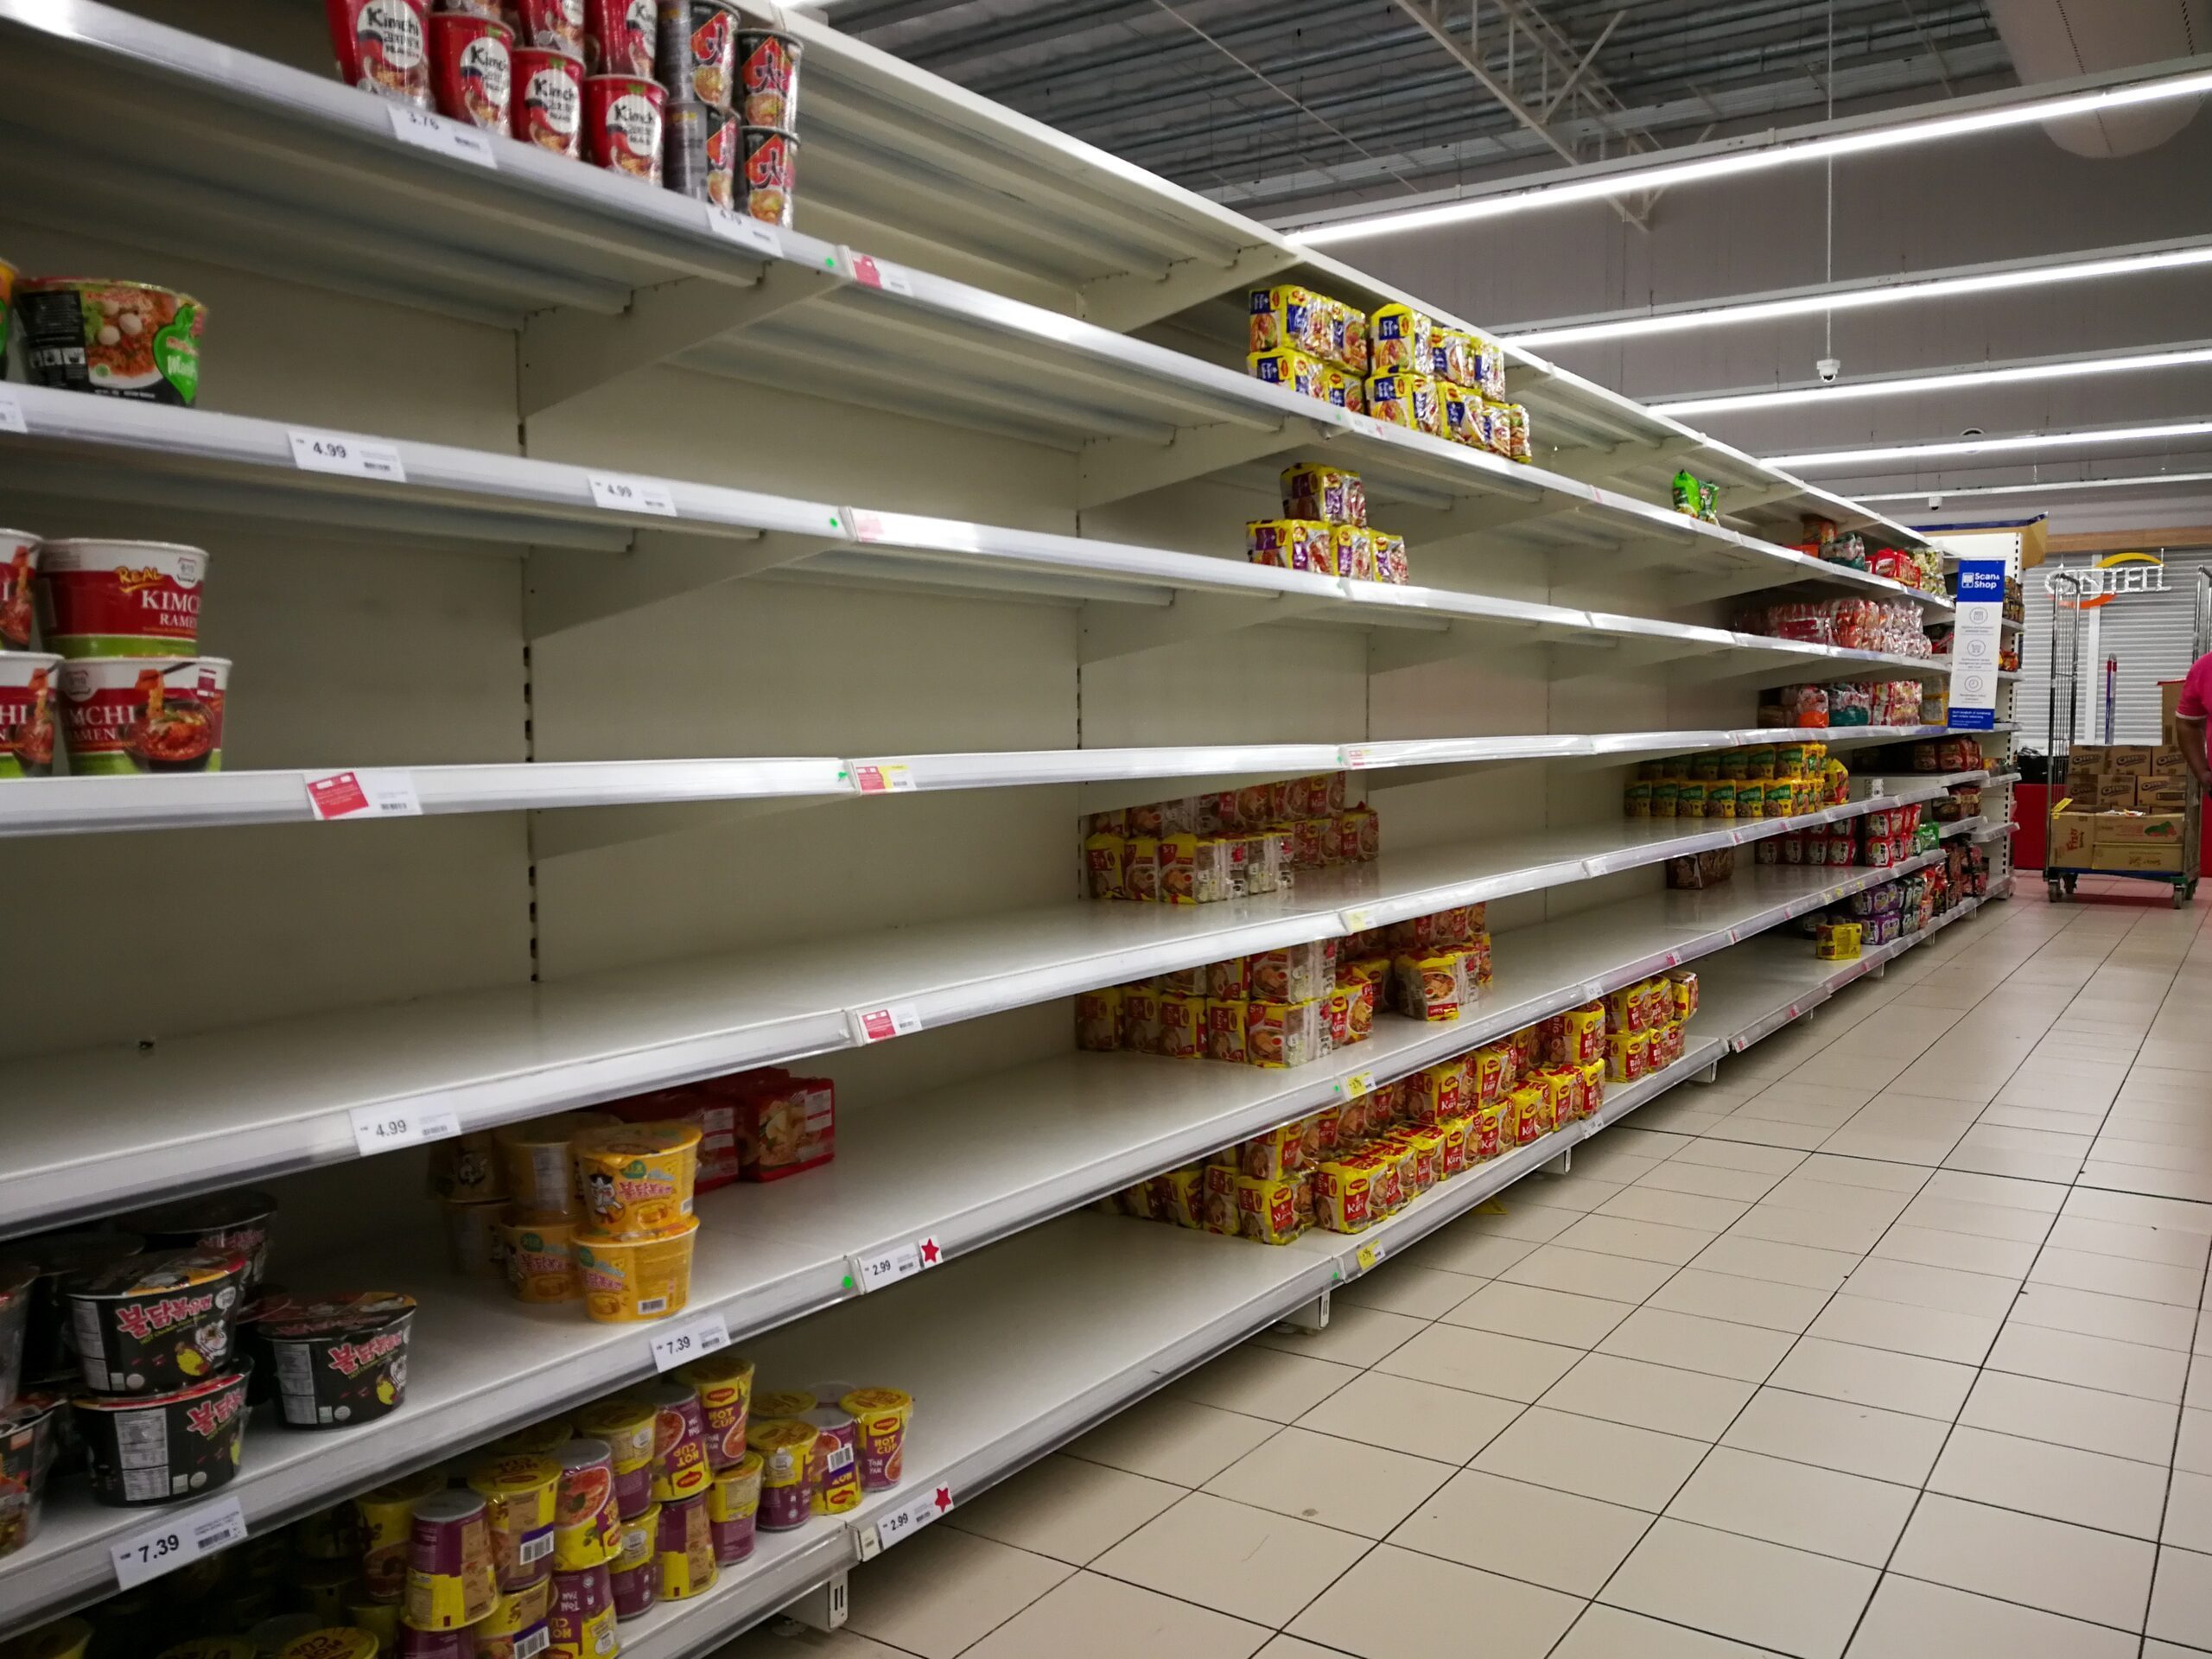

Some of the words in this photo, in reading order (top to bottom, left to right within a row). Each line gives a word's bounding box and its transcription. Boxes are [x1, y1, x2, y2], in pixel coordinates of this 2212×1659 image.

[313, 441, 347, 459] 4.99
[1974, 580, 1998, 590] Shop
[376, 1119, 407, 1138] 4.99
[872, 1260, 892, 1276] 2.99
[666, 1336, 690, 1355] 7.39
[709, 1407, 734, 1421] HOT
[712, 1416, 737, 1429] CUP
[874, 1434, 897, 1447] HOT
[673, 1442, 696, 1458] CUP
[877, 1443, 898, 1455] CUP
[677, 1449, 700, 1468] HOT
[890, 1512, 909, 1531] 2.99
[138, 1534, 180, 1564] 7.39
